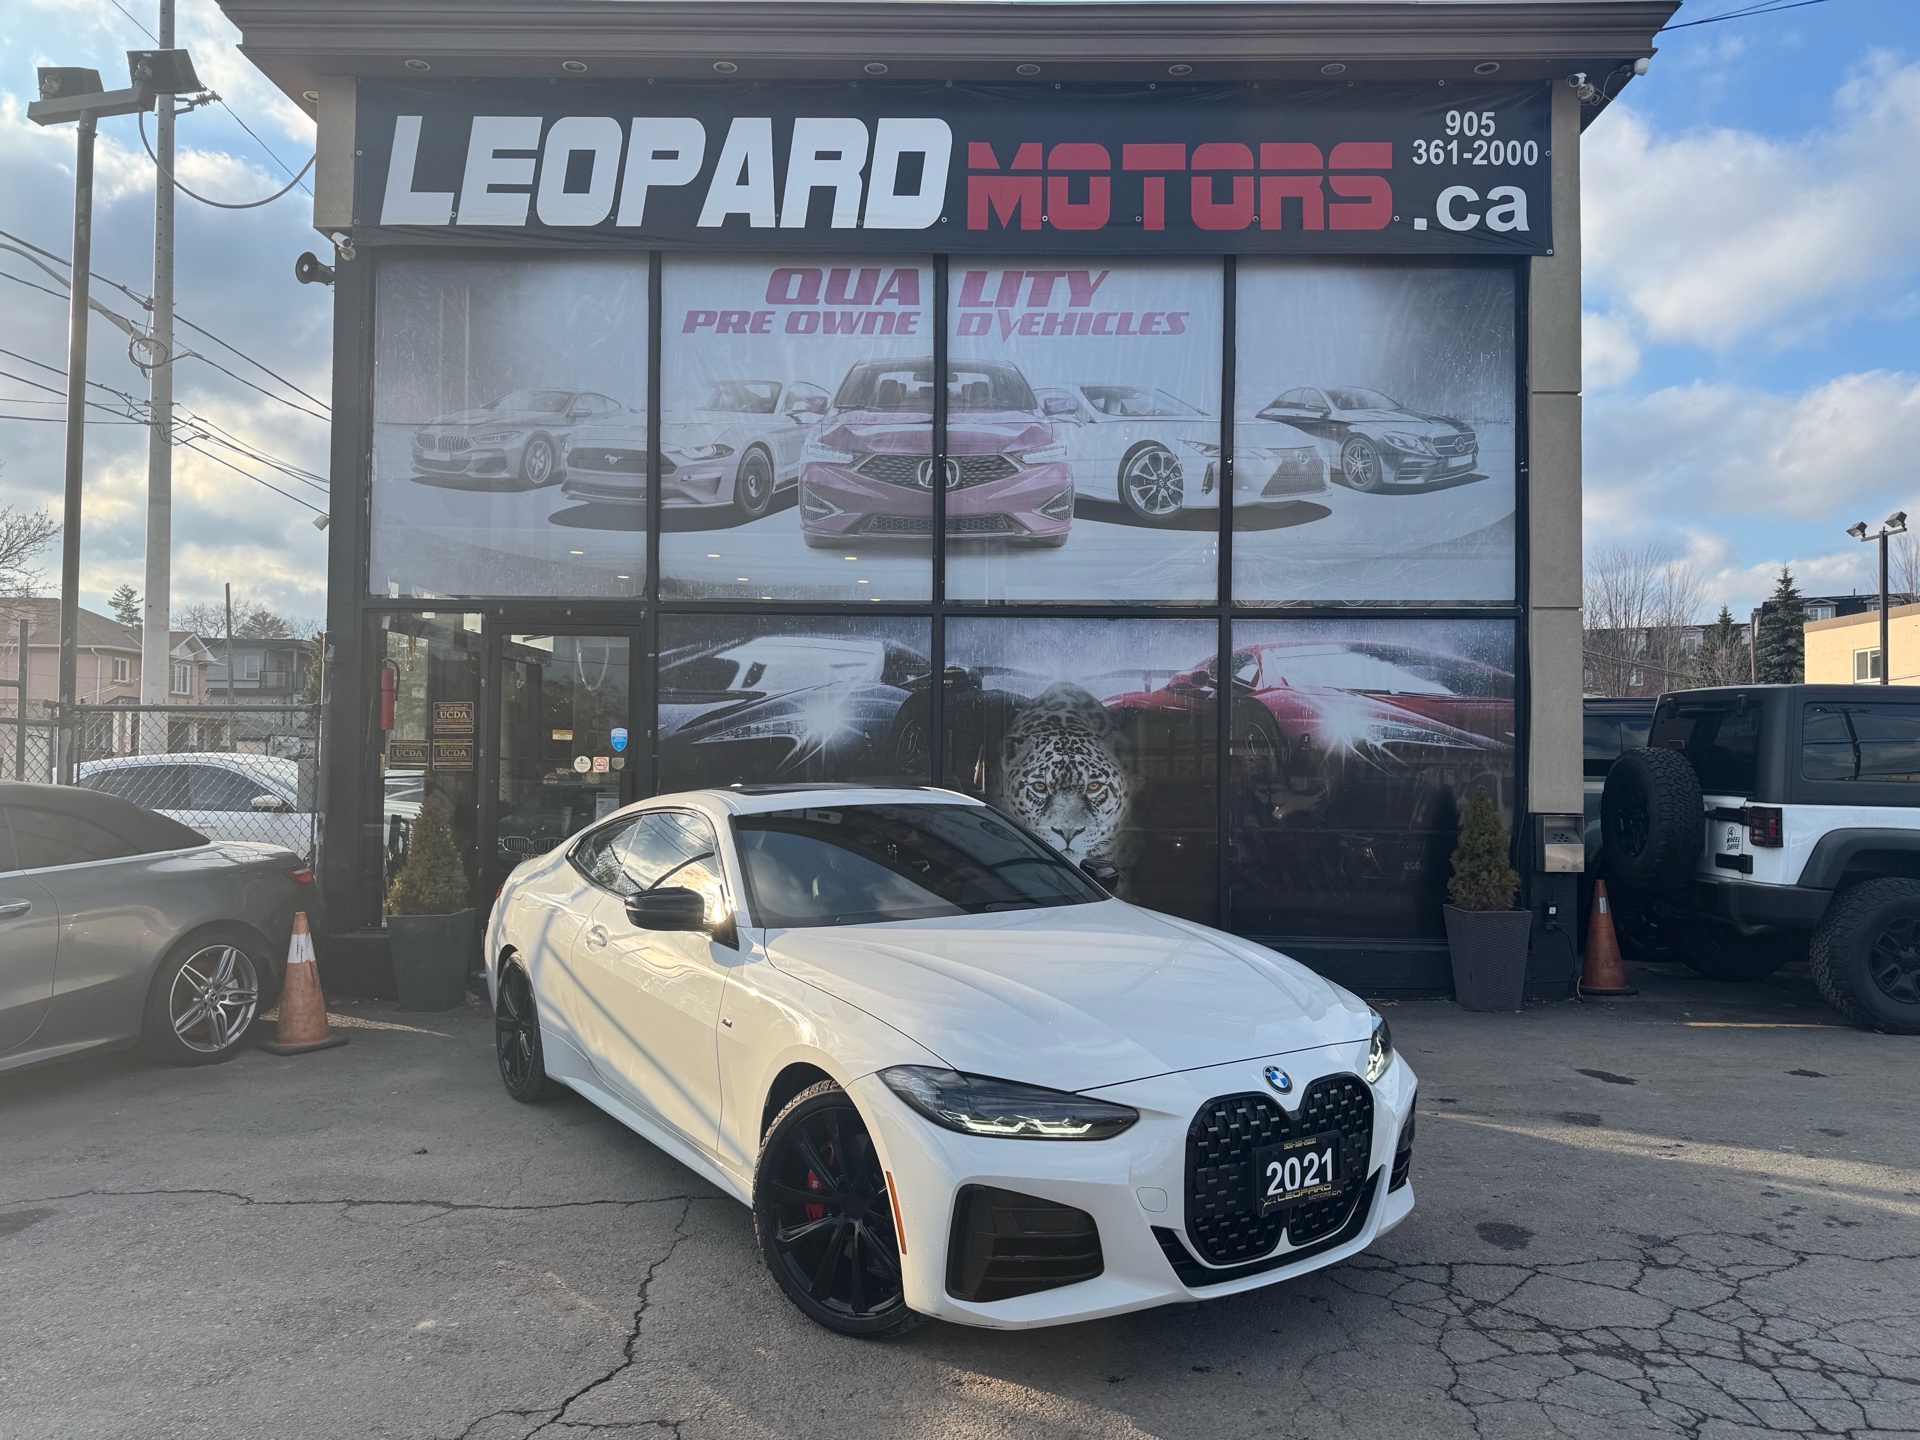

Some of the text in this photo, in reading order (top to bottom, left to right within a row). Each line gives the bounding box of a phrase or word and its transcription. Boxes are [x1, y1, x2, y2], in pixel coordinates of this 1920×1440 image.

[1445, 110, 1496, 137] 905
[1412, 139, 1538, 166] 361-2000
[380, 115, 952, 230] LEOPARD
[967, 142, 1392, 231] MOTORS
[682, 310, 775, 334] PRE
[440, 711, 468, 719] UCDA
[395, 749, 423, 757] UCDA
[440, 749, 467, 757] UCDA
[1266, 1147, 1333, 1196] 2021
[1277, 1183, 1331, 1202] LEOPARD
